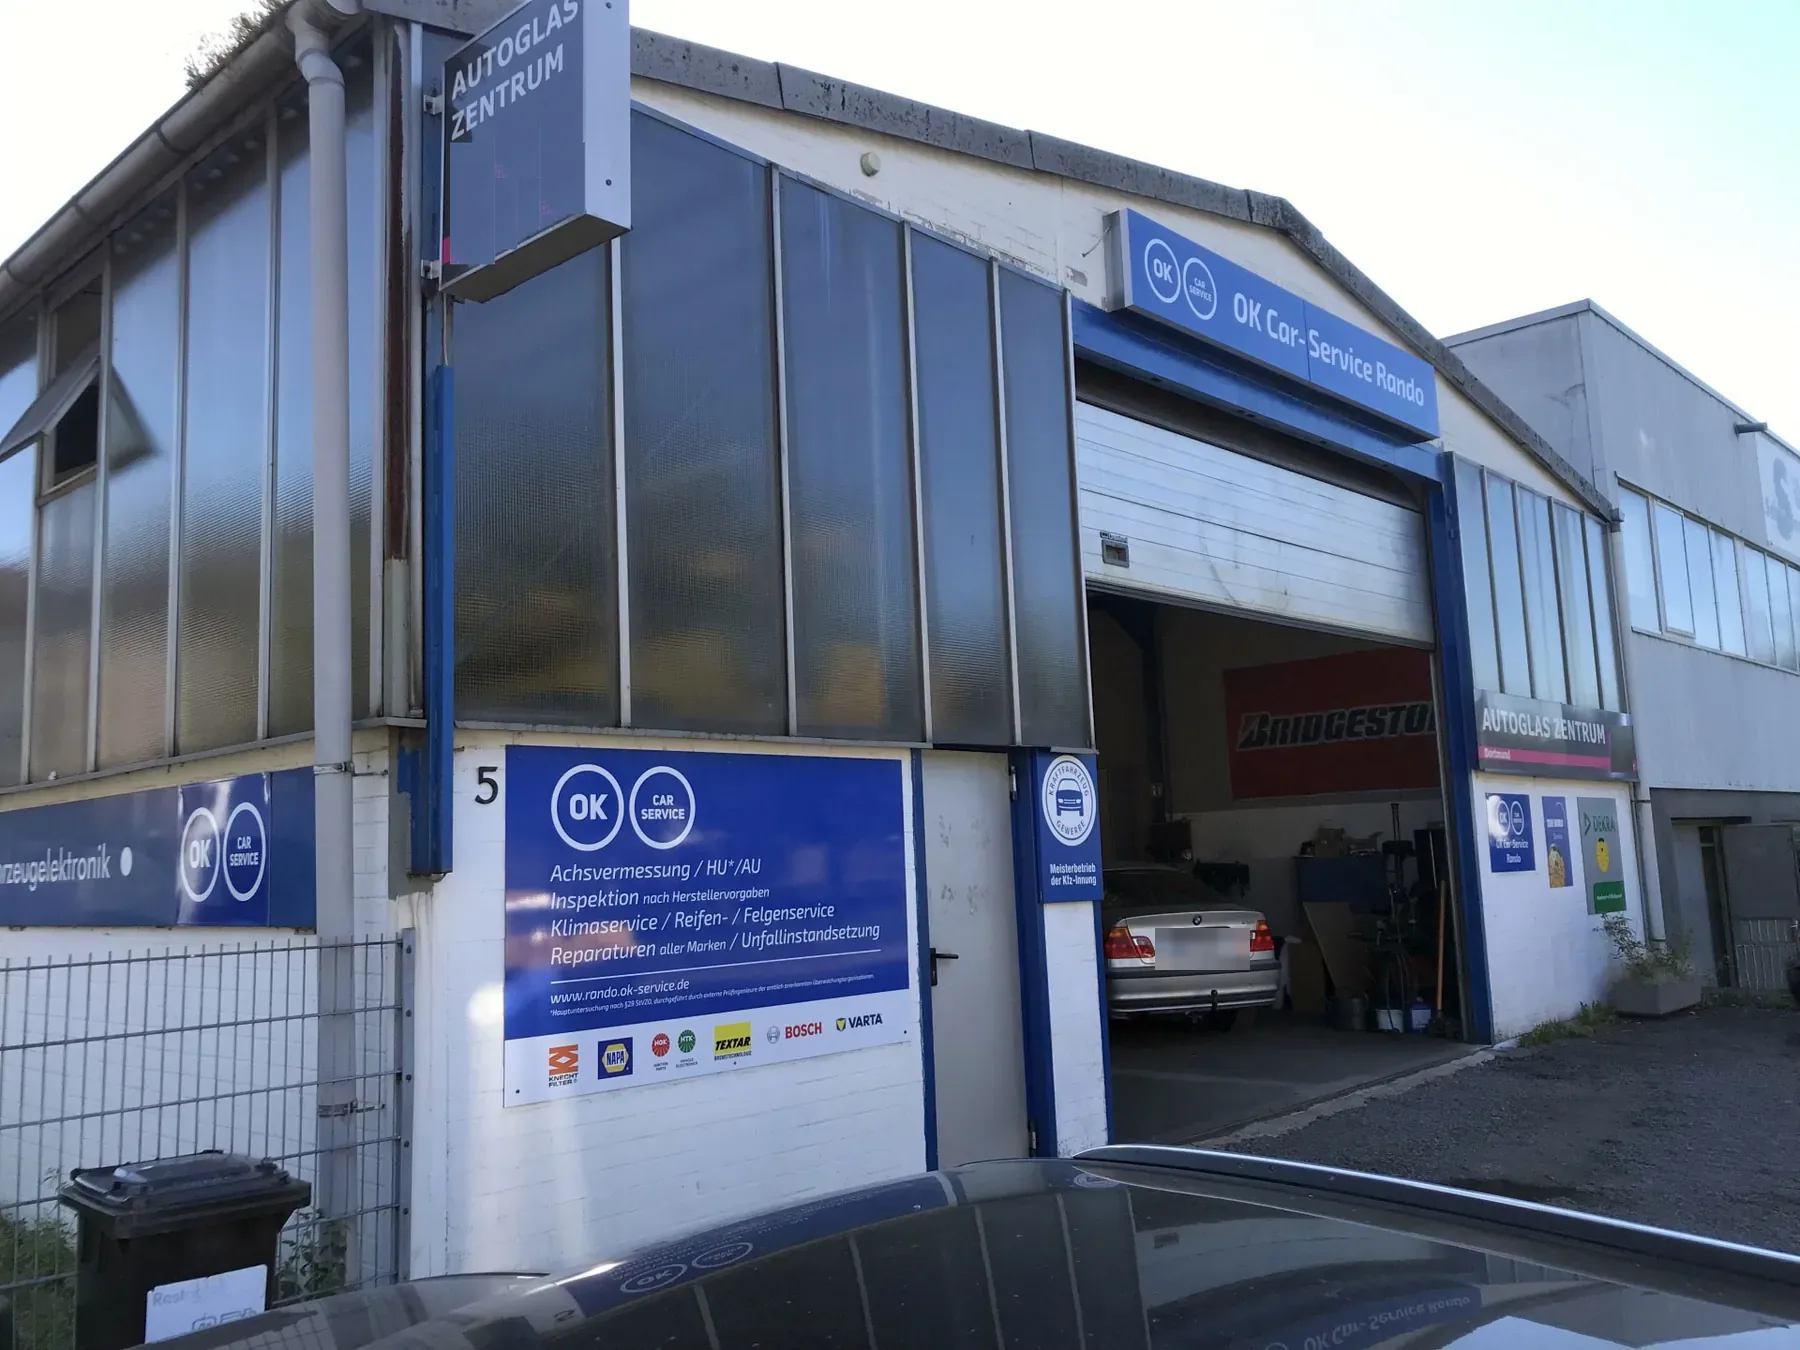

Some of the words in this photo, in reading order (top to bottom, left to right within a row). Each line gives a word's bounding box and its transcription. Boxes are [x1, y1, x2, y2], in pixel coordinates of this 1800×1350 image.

[451, 0, 579, 101] AUTOGLAS
[451, 43, 564, 141] ZENTRUM
[1152, 257, 1174, 285] OK
[1193, 277, 1206, 289] CAR
[1188, 285, 1213, 303] SERVICE
[1233, 292, 1262, 332] OK
[1376, 360, 1425, 407] Rando
[1482, 707, 1550, 739] AUTOGLAS
[1553, 718, 1606, 745] ZENTRUM
[1484, 747, 1511, 760] Dortmund
[474, 766, 499, 805] 5
[1048, 765, 1089, 797] KRAFTFAHRZEUG
[569, 793, 609, 821] OK
[652, 794, 674, 806] CAR
[640, 808, 686, 820] SERVICE
[1593, 814, 1616, 832] DEKRA
[1056, 820, 1086, 836] GEWERBE
[236, 836, 252, 850] CAR
[189, 839, 213, 869] OK
[229, 852, 259, 867] SERVICE
[1507, 853, 1522, 864] Rando
[550, 864, 690, 882] Achsvermessung
[1050, 863, 1096, 874] Meisterbetrieb
[1050, 876, 1062, 886] der
[1062, 875, 1097, 887] Kfz-Innung
[551, 889, 639, 912] Inspektion
[643, 892, 670, 905] nach
[672, 887, 770, 902] Herstellervorgaben
[551, 914, 658, 937] Klimaservice
[674, 909, 729, 931] Reifen-
[744, 903, 835, 926] Felgenservice
[551, 943, 656, 968] Reparaturen
[660, 943, 686, 956] aller
[687, 939, 727, 953] Marken
[741, 924, 880, 951] Unfallinstandsetzung
[550, 978, 690, 1004] www.rando.ok-service.de
[610, 1002, 624, 1010] nach
[848, 1013, 883, 1029] VARTA
[785, 1022, 822, 1040] BOSCH
[715, 1036, 751, 1051] TEXTAR
[606, 1050, 625, 1066] NAPA
[548, 1072, 579, 1082] KNECHT
[548, 1079, 573, 1088] FILTER
